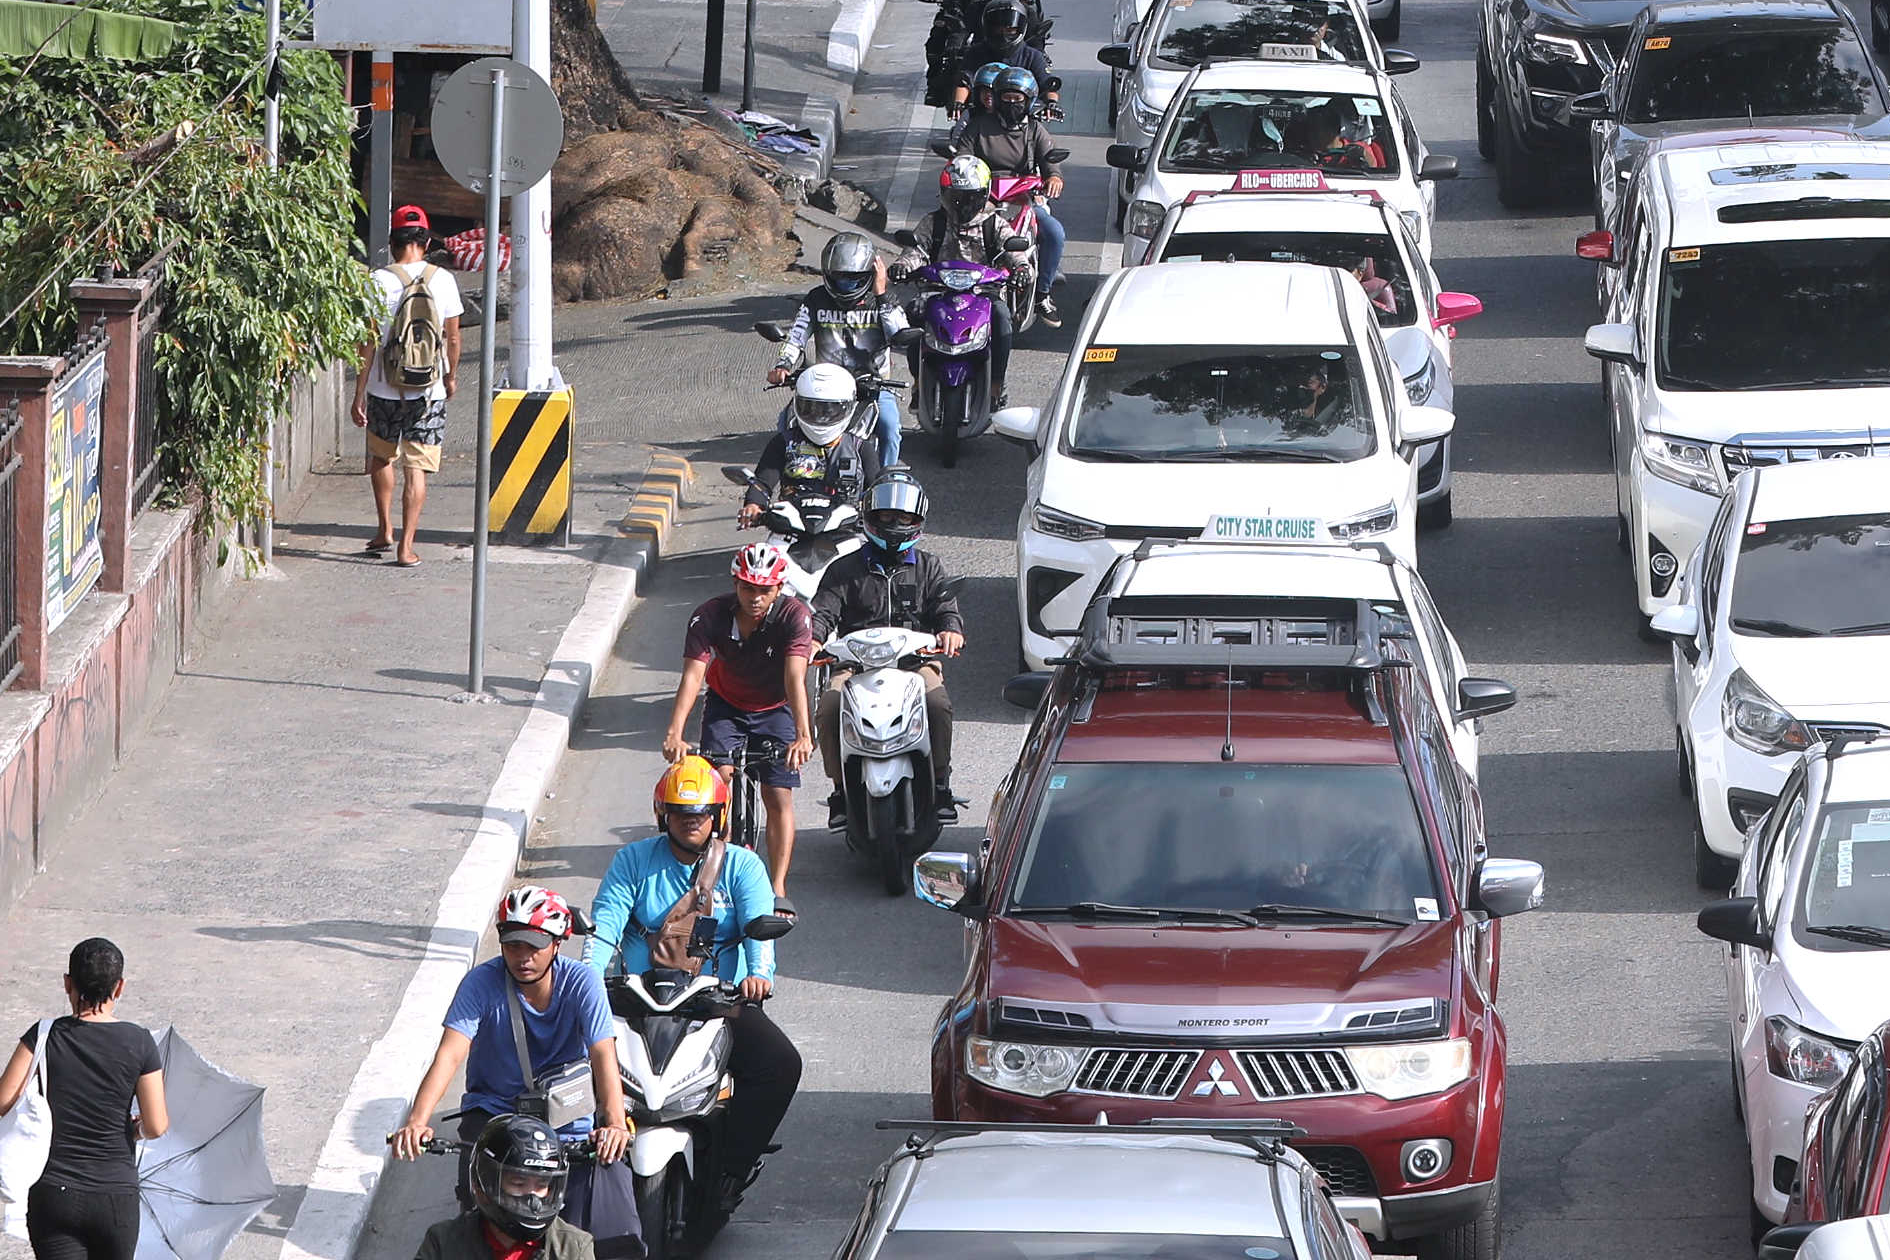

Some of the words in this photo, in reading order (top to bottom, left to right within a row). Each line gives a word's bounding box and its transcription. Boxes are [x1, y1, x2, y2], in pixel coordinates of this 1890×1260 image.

[1270, 45, 1309, 57] TAXI
[1241, 173, 1260, 189] RLO
[817, 309, 844, 323] CALL
[1216, 517, 1241, 537] CITY
[1244, 518, 1274, 538] STAR
[1276, 519, 1316, 539] CRUISE
[1178, 1019, 1230, 1028] MONTERO
[1233, 1019, 1271, 1027] SPORT
